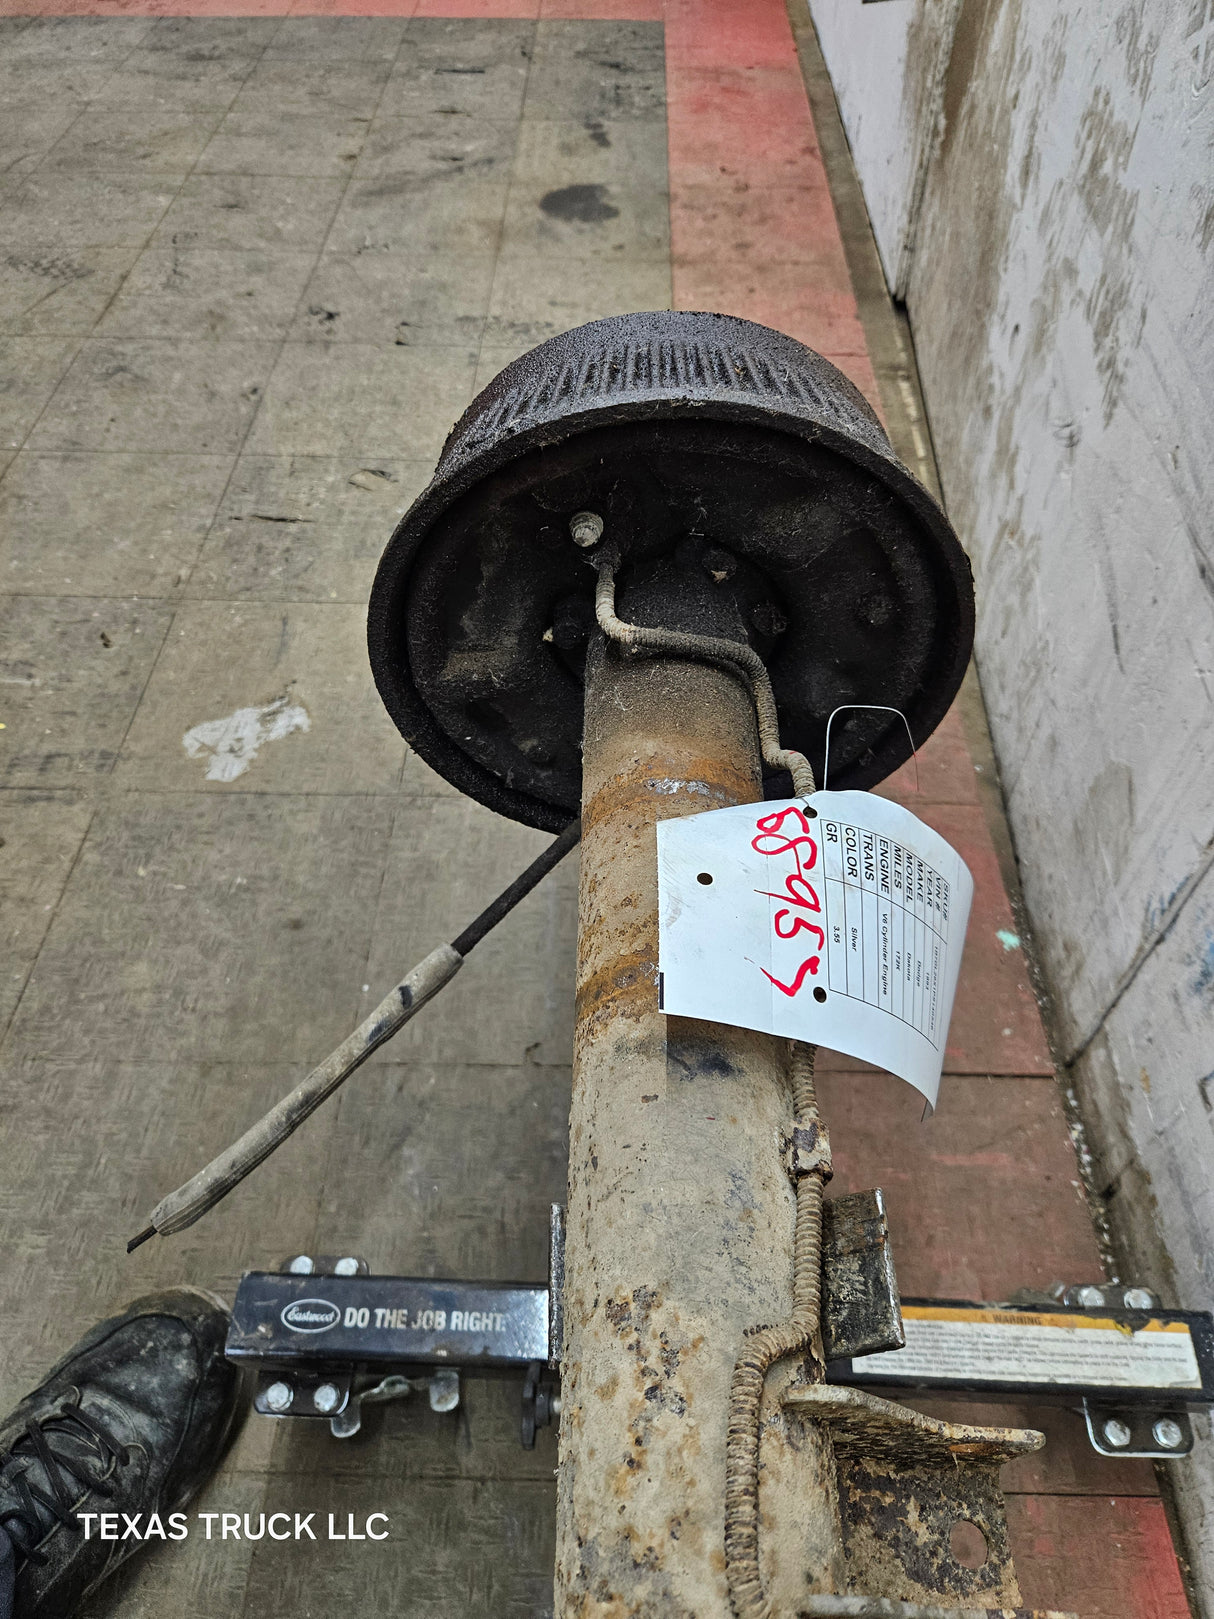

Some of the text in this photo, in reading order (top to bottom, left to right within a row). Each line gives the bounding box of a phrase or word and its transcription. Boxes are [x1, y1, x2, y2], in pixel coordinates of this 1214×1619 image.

[825, 822, 838, 843] GR
[845, 827, 858, 878] COLOR
[863, 834, 874, 881] TRANS
[879, 838, 890, 895] ENGINE
[894, 845, 902, 890] MILES
[905, 852, 913, 904] MODEL
[881, 926, 889, 962] Cylinder
[286, 1306, 335, 1323] Eastwood
[344, 1307, 369, 1328] DO
[375, 1308, 406, 1329] THE
[412, 1309, 446, 1331] JOB
[992, 1313, 1043, 1325] WARNING
